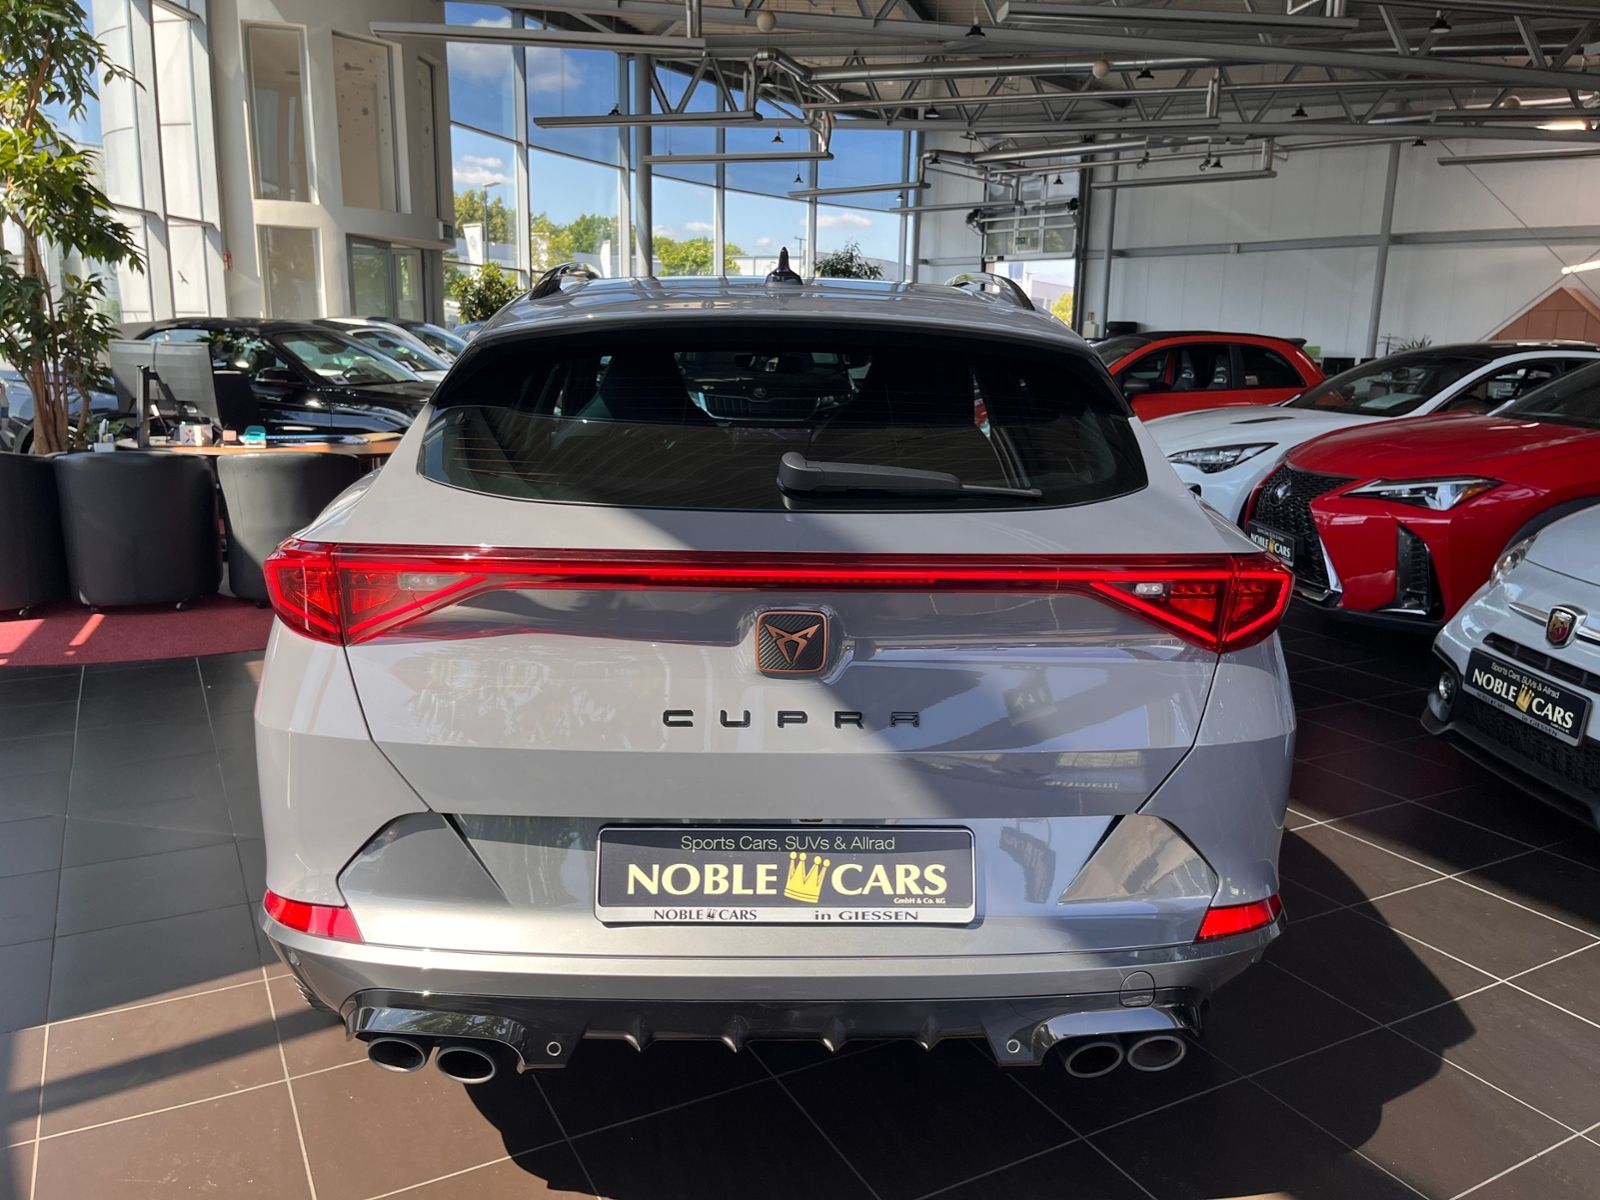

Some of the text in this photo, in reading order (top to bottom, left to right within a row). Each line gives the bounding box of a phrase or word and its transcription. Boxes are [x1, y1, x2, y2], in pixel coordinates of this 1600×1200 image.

[1274, 543, 1291, 558] CARS
[1472, 668, 1518, 703] NOBLE
[1531, 697, 1574, 729] CARS
[662, 709, 920, 729] CUPRA
[681, 835, 896, 853] Sports Cars, SUVs & Allrad
[627, 863, 948, 896] NOBLE CARS
[893, 897, 946, 905] GmbH & Co. KG
[653, 909, 758, 921] NOBLE CARS
[814, 910, 919, 921] in GIESSEN
